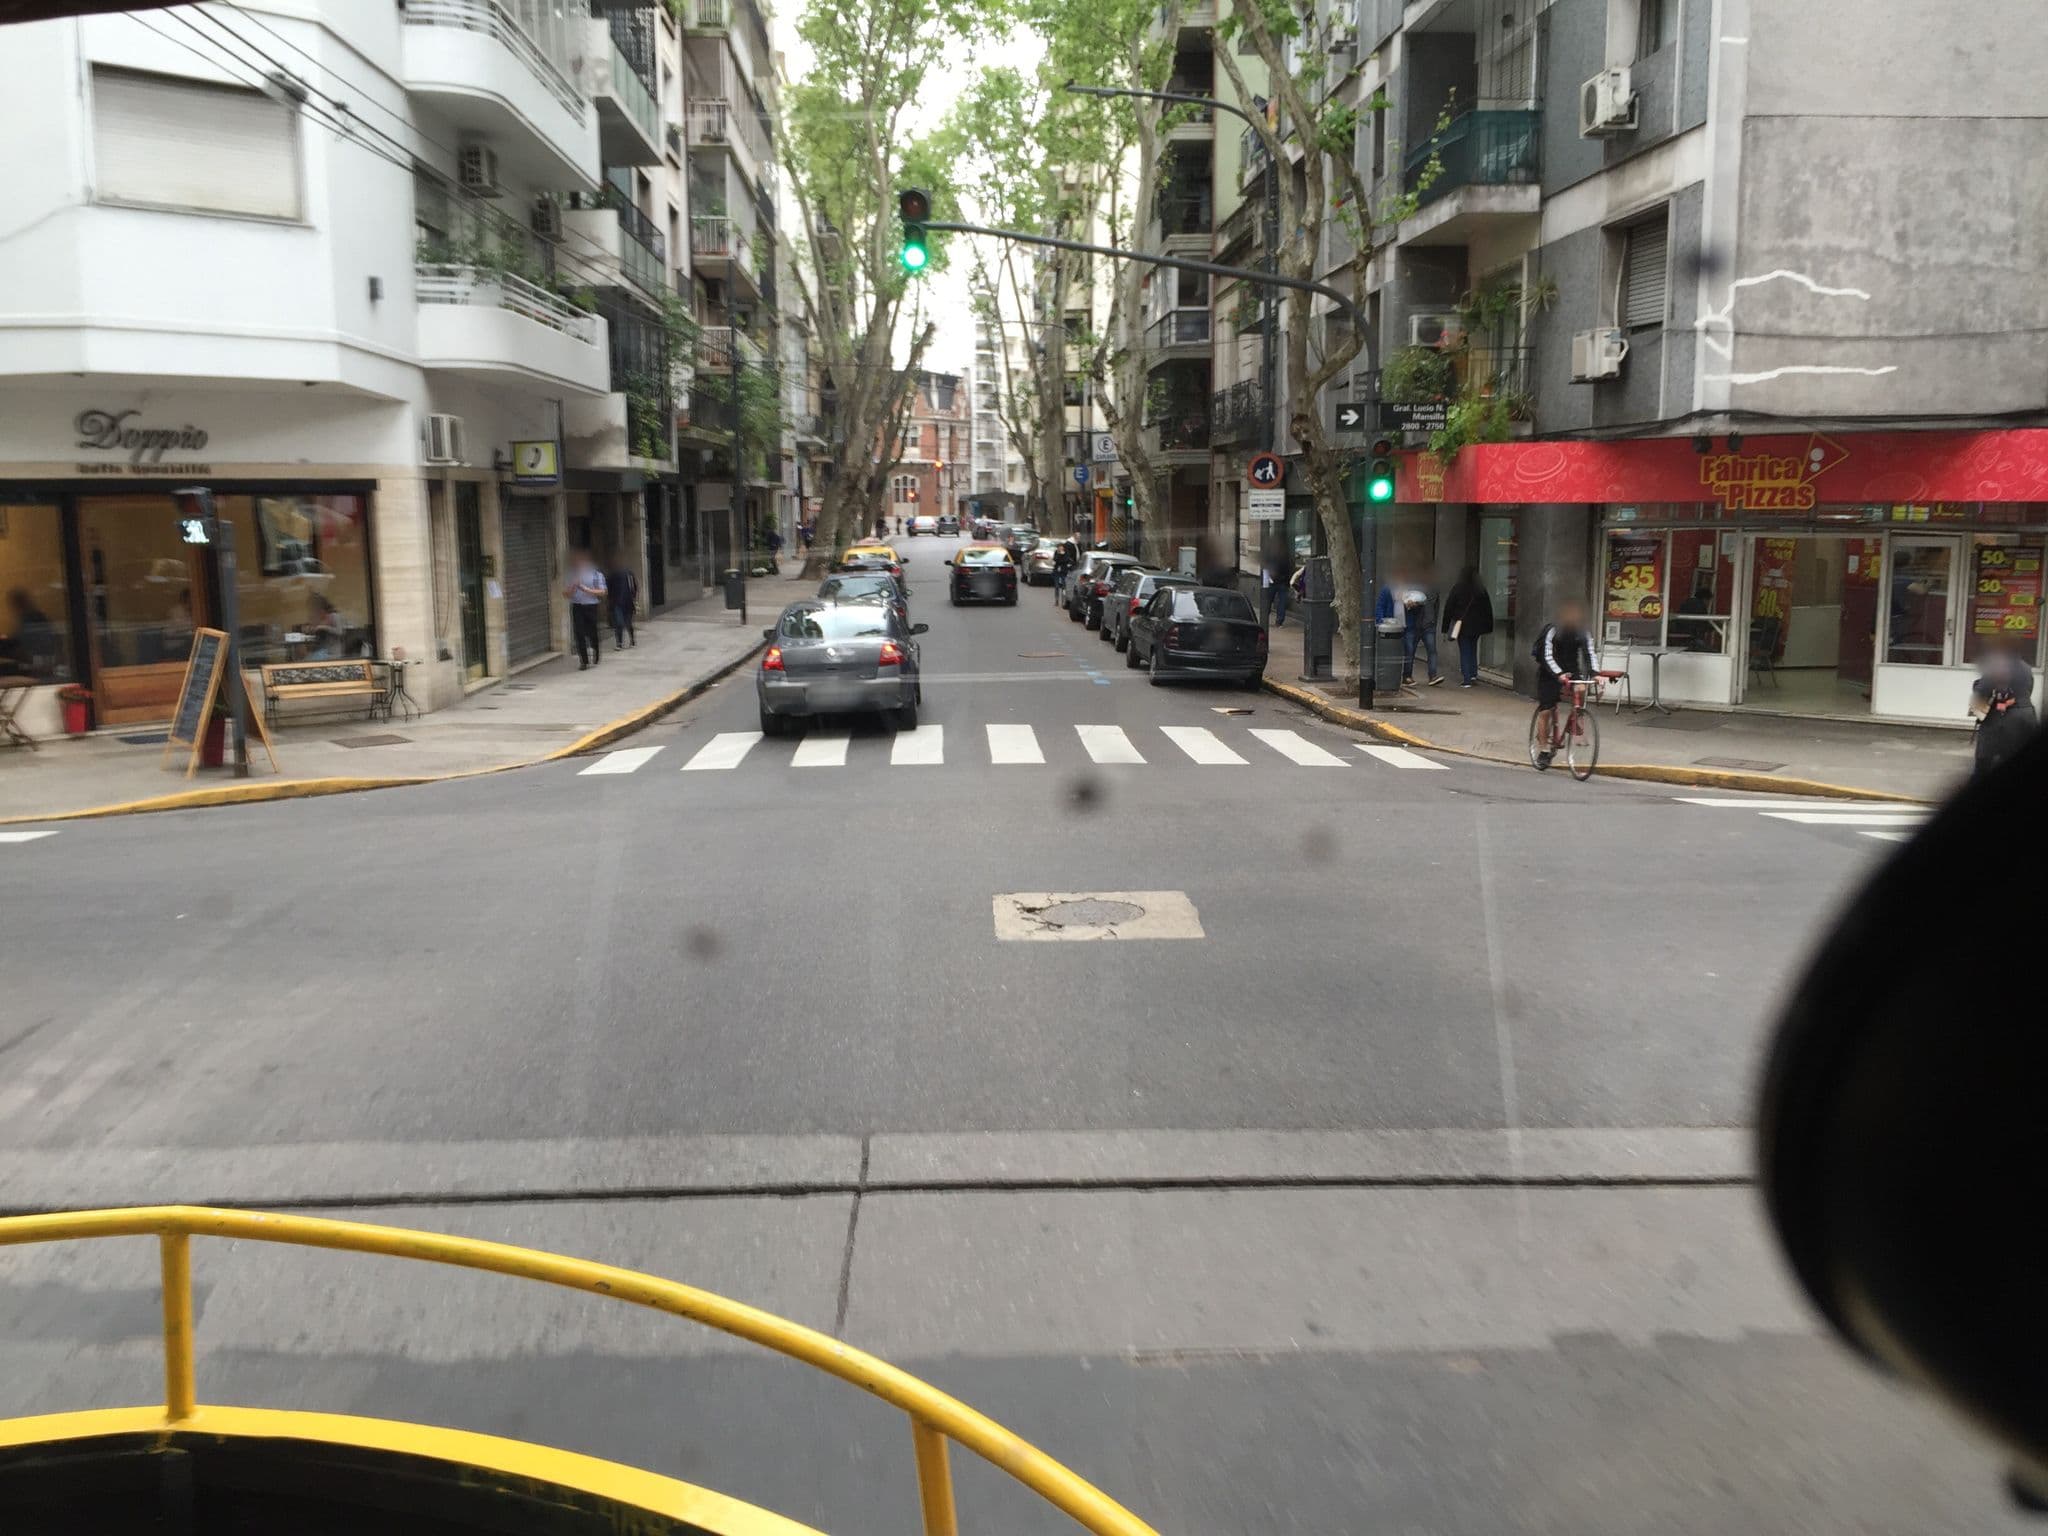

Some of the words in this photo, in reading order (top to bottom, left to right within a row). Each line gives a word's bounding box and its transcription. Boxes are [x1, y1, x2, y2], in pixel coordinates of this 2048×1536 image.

[1413, 404, 1434, 412] Lucio
[1412, 413, 1445, 421] Mansilla
[1426, 422, 1444, 430] 2750
[75, 410, 209, 465] Doppio
[1076, 466, 1084, 478] E
[1702, 456, 1799, 482] Fábrica
[1727, 484, 1815, 509] Pizzas
